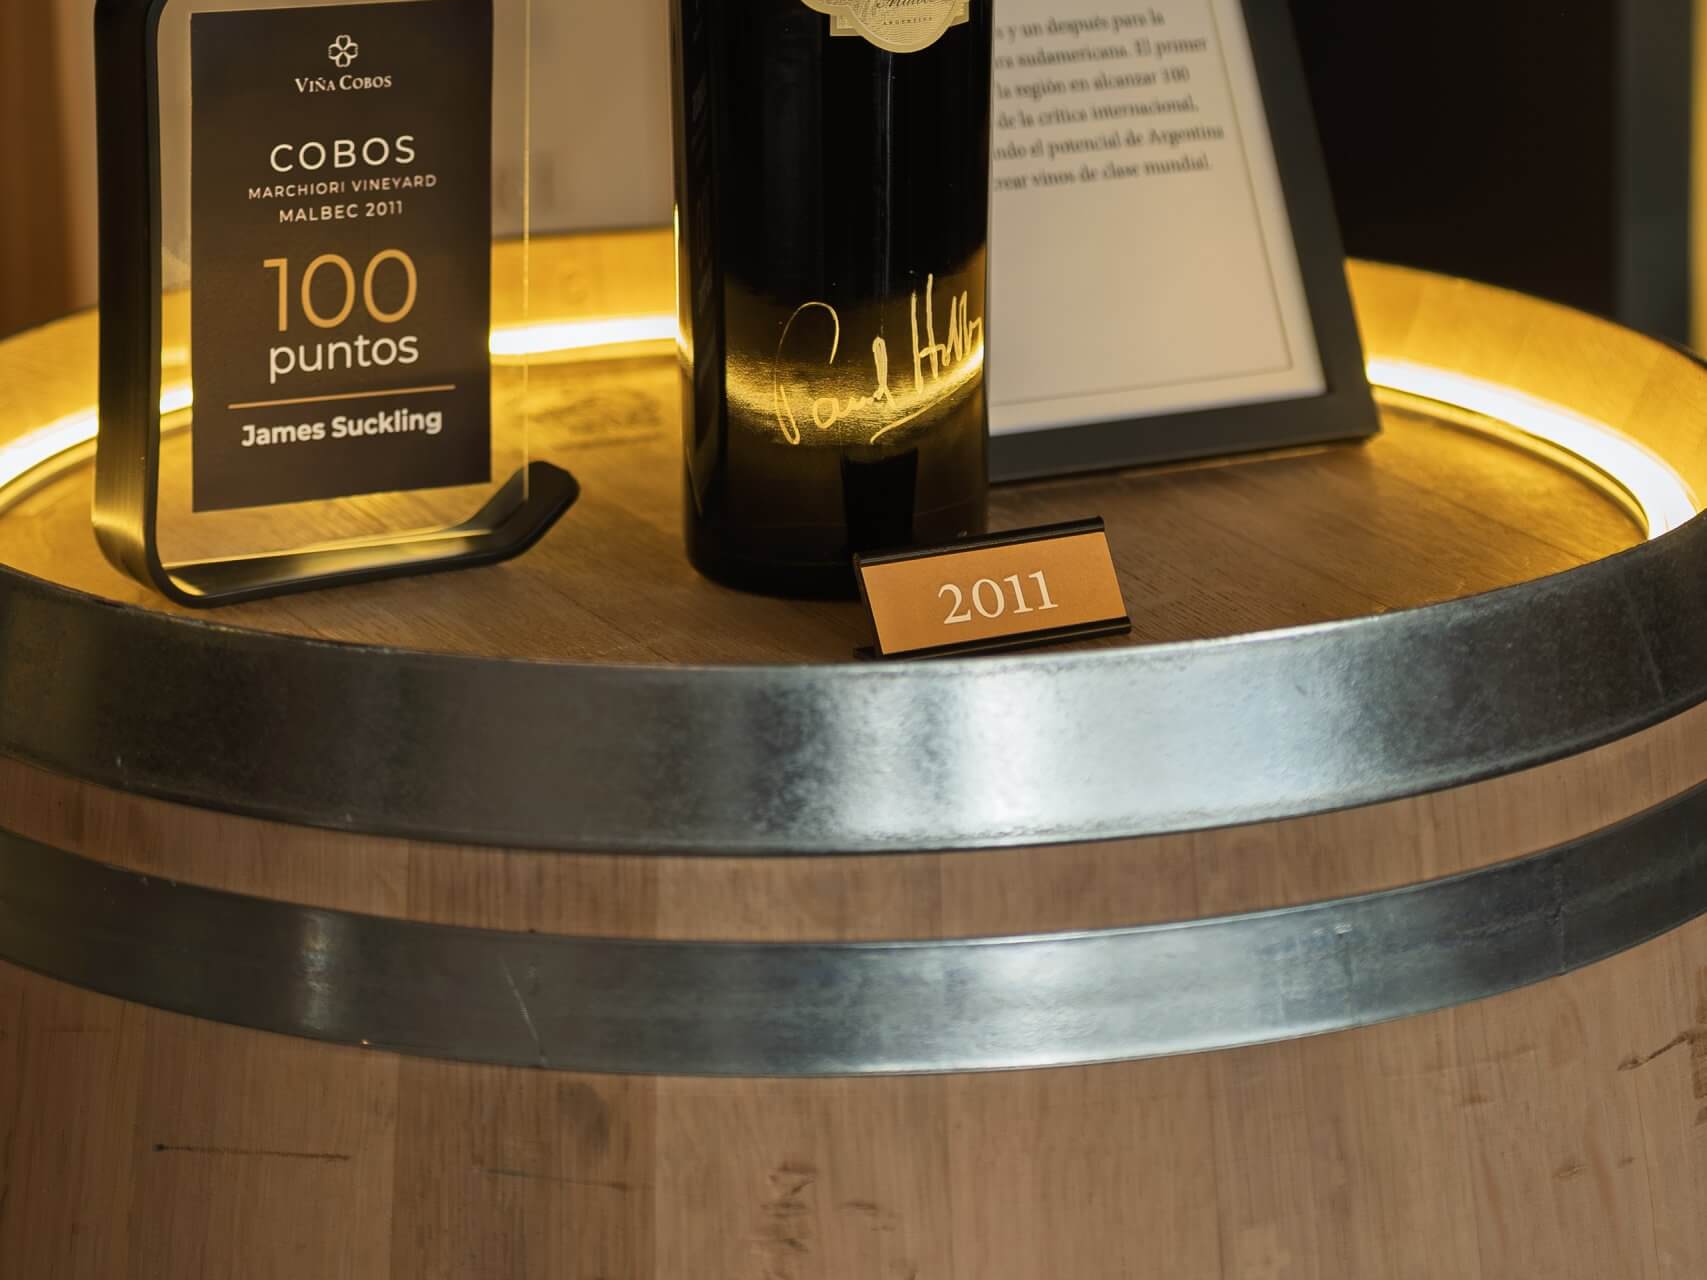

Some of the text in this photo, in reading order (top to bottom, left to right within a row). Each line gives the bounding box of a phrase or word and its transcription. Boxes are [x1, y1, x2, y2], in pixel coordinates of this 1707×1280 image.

[1111, 12, 1147, 33] para
[1147, 6, 1166, 26] la
[1156, 37, 1208, 60] primer
[1015, 77, 1066, 102] región
[1069, 78, 1090, 92] en
[1148, 124, 1225, 148] Argentina
[270, 135, 416, 172] COBOS
[248, 174, 438, 200] MARCHIORI VINEYARD
[279, 200, 403, 223] MALBEC 2011
[263, 249, 418, 332] 100
[269, 334, 419, 385] puntos
[241, 408, 443, 447] James Suckling
[937, 570, 1059, 625] 2011
